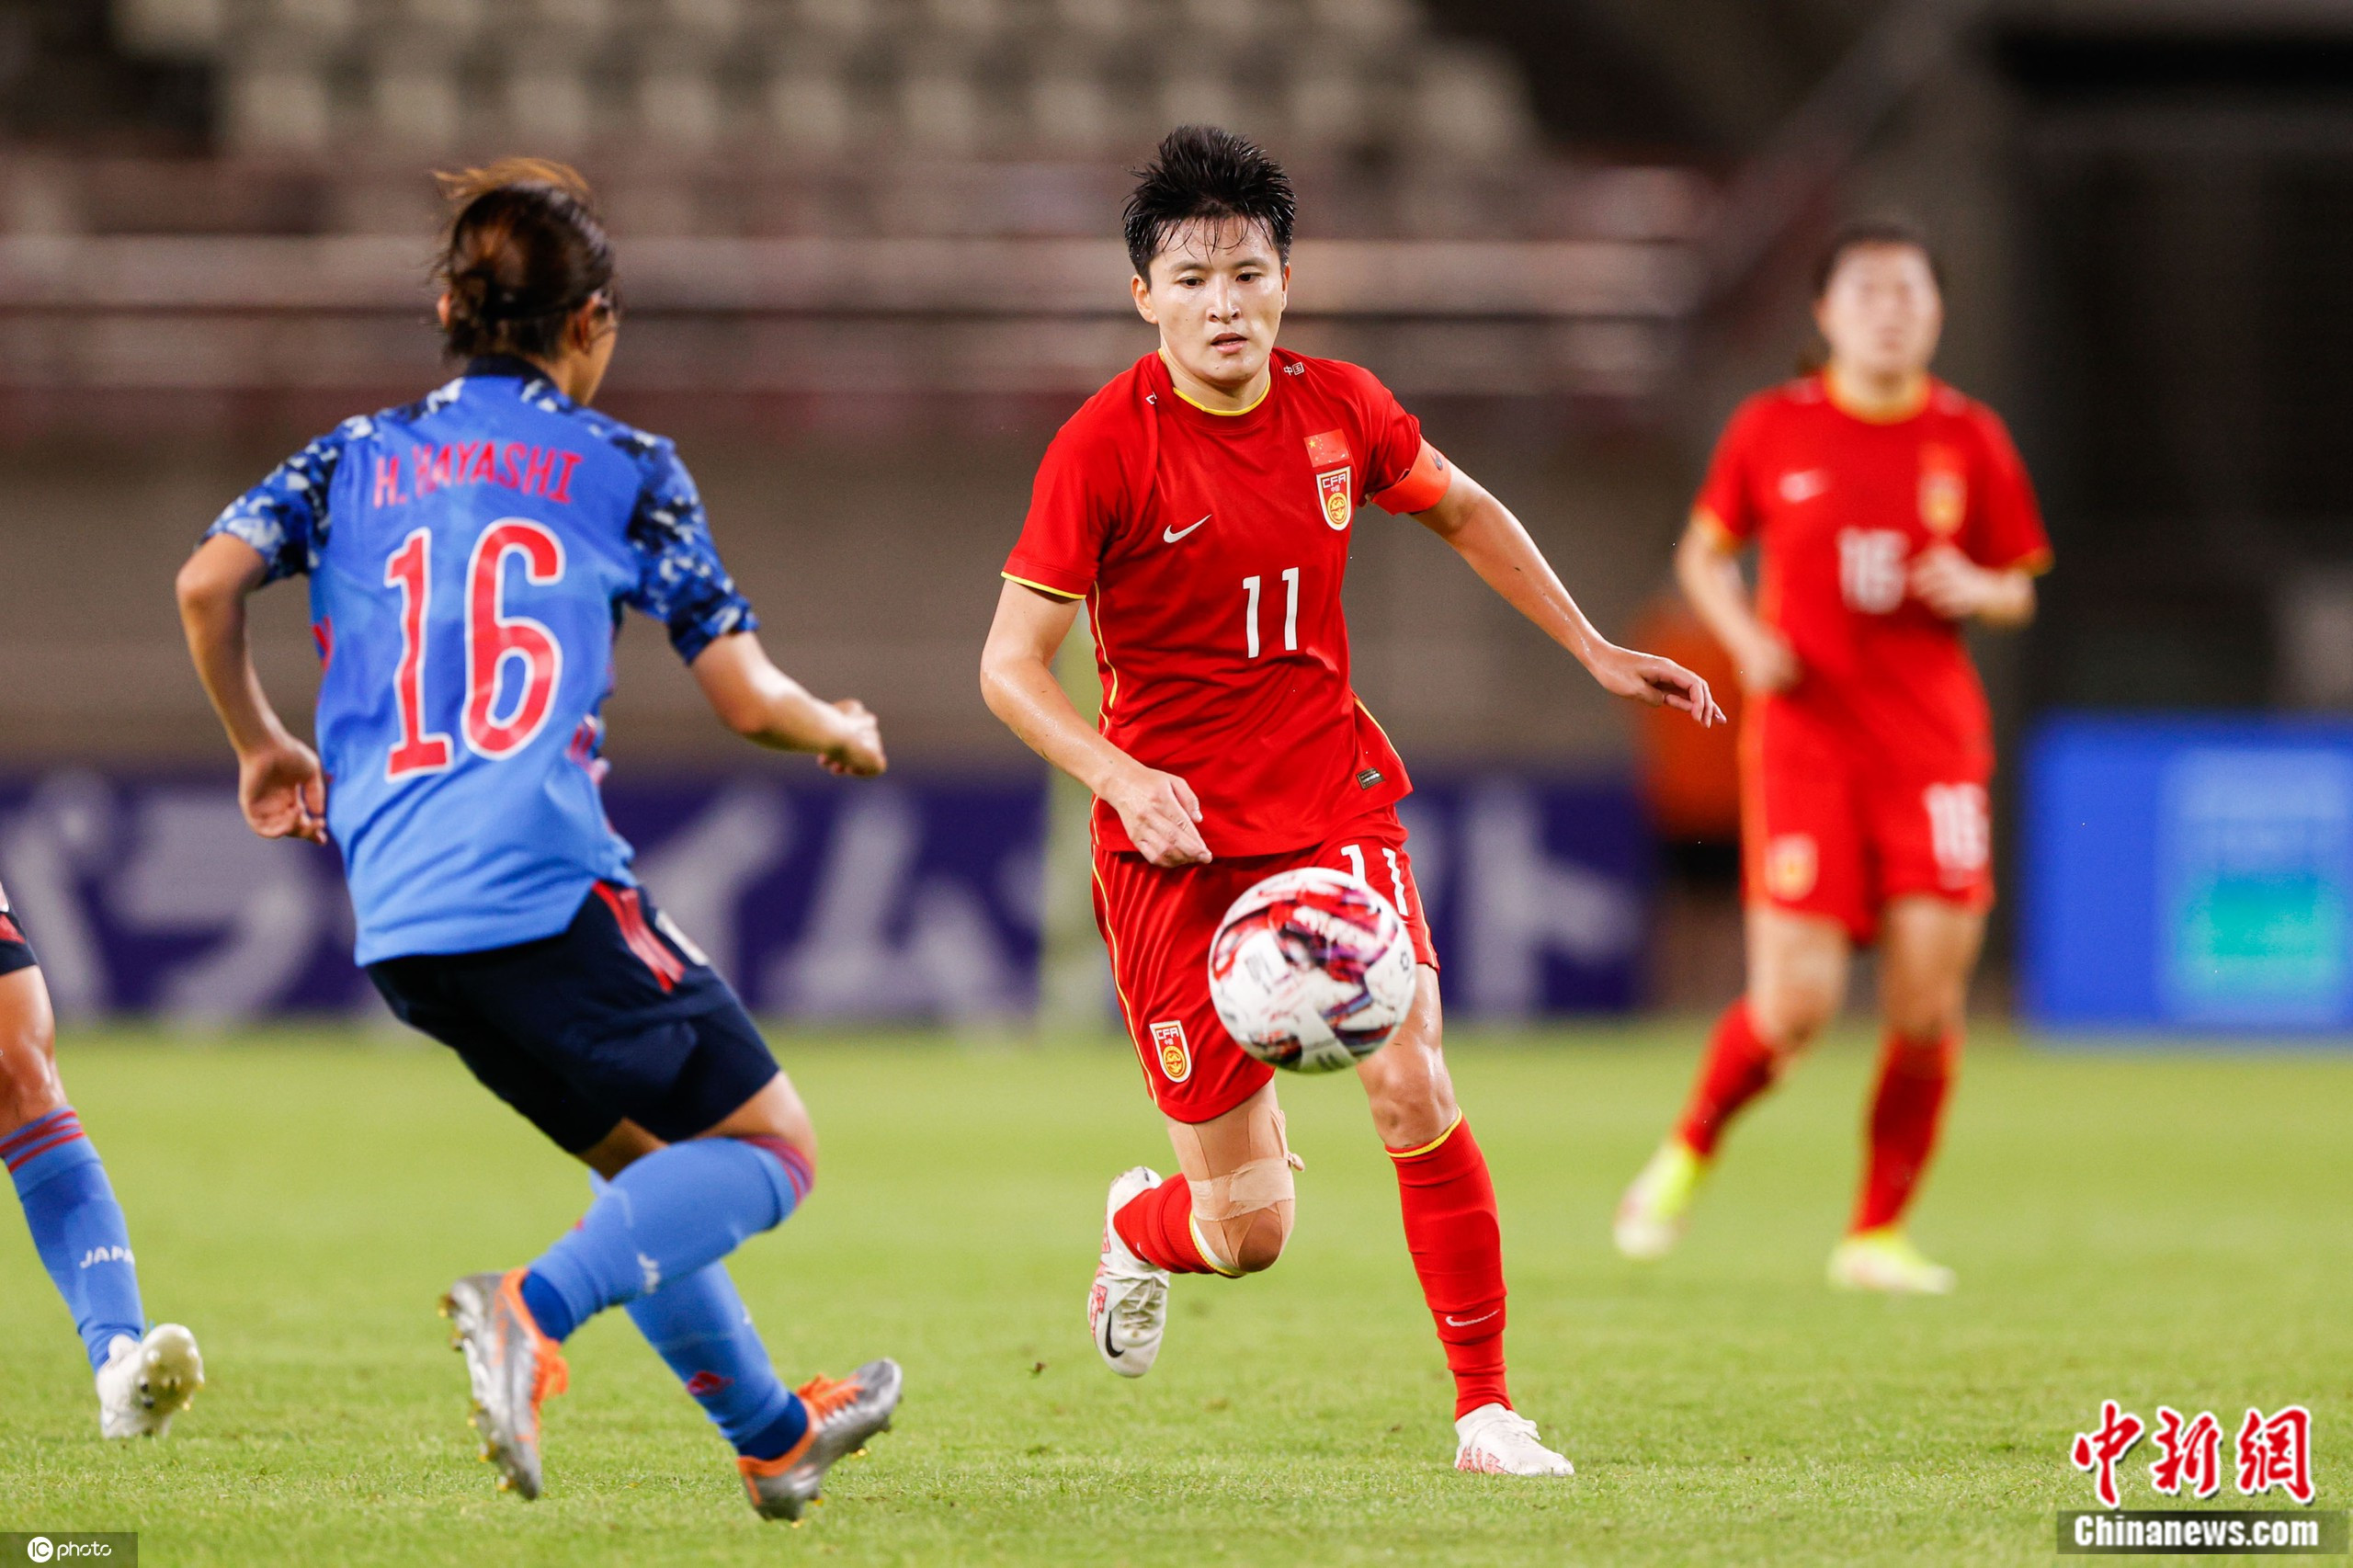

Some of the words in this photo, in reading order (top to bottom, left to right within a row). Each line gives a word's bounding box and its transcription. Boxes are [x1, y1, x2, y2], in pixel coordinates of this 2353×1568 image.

[1283, 361, 1304, 376] 中国
[372, 456, 407, 508] H.
[412, 441, 583, 505] HAYASHI
[1323, 473, 1347, 489] CFA
[1243, 567, 1300, 659] 11
[384, 517, 566, 783] 16
[1340, 844, 1409, 917] 11
[1156, 1027, 1179, 1040] CFA
